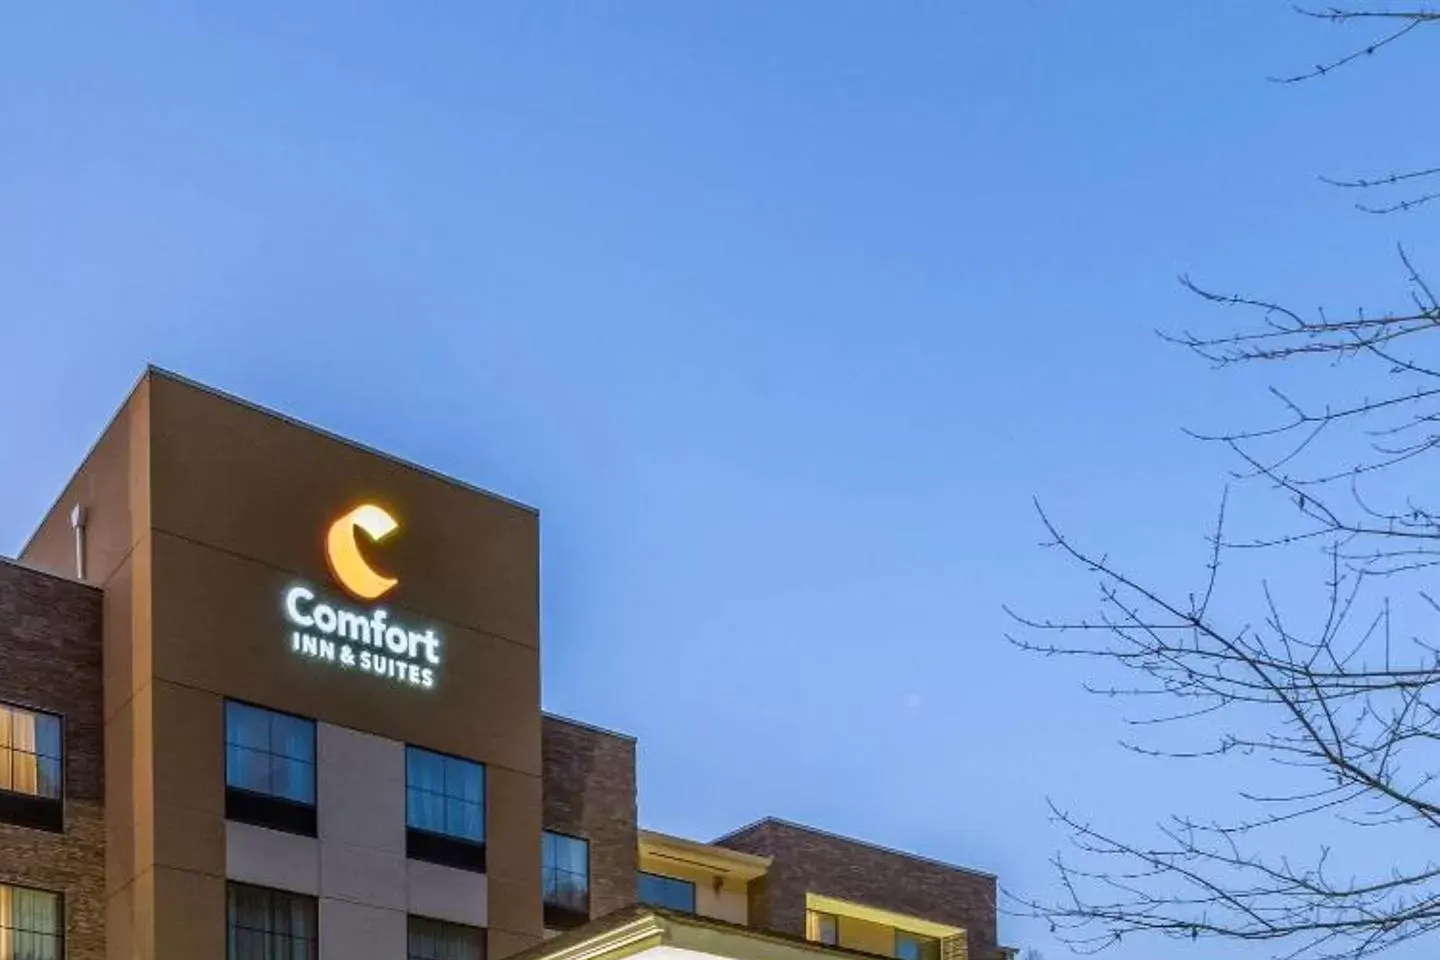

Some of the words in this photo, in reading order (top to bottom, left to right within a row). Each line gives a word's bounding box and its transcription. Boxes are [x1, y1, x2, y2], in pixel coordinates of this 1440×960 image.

[286, 586, 440, 664] Comfort
[292, 631, 335, 661] INN
[339, 644, 356, 666] &
[360, 650, 434, 688] SUITES
